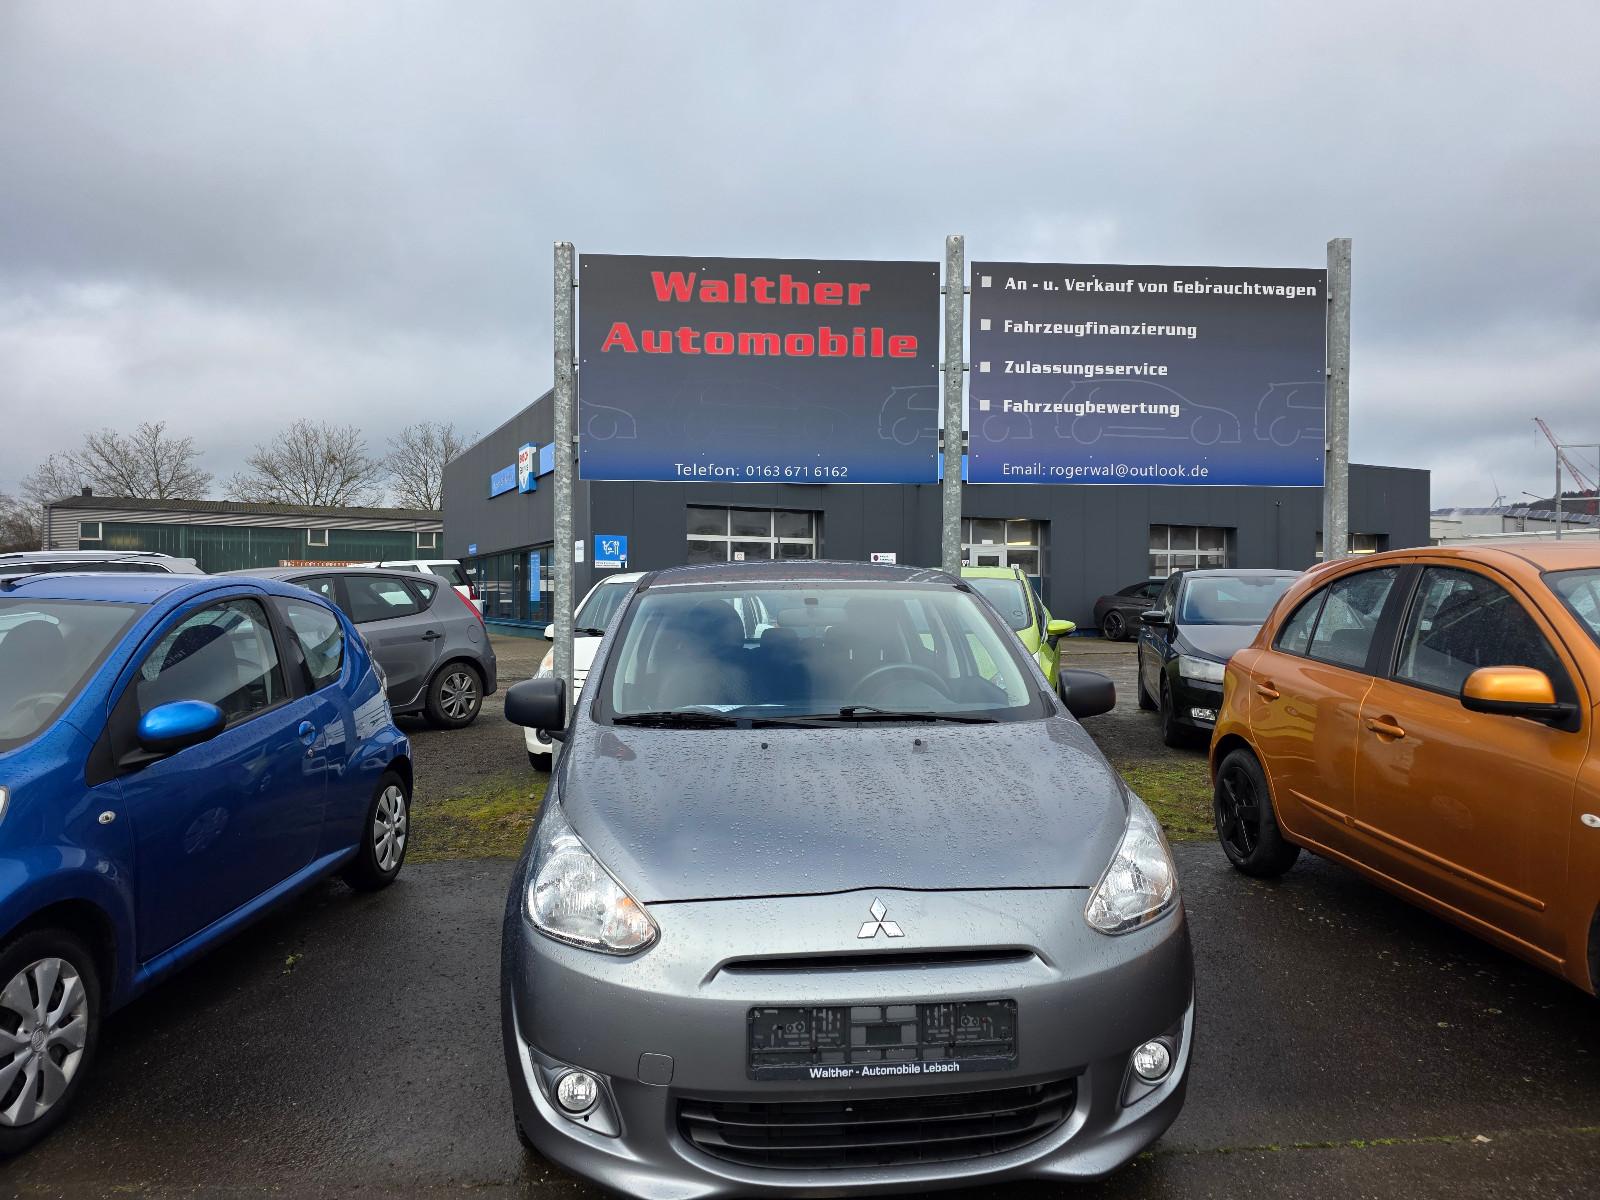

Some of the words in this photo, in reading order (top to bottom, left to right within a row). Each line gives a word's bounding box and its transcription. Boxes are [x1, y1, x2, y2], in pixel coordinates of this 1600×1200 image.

[651, 271, 871, 305] Walther
[1005, 276, 1027, 291] An
[1043, 280, 1060, 291] u.
[1064, 278, 1135, 293] Verkauf
[1137, 282, 1168, 293] von
[1172, 279, 1317, 298] Gebrauchtwagen
[1004, 319, 1197, 339] Fahrzeugfinanzierung
[601, 322, 918, 358] Automobile
[1004, 360, 1168, 378] Zulassungsservice
[1003, 399, 1180, 418] Fahrzeugbewertung
[675, 463, 740, 477] Telefon:
[746, 465, 780, 478] 0163
[784, 465, 808, 478] 671
[814, 465, 848, 478] 6162
[1003, 463, 1046, 476] Email:
[1050, 463, 1209, 480] rogerwal@outlook.de
[809, 1067, 854, 1079] Walther
[861, 1063, 921, 1077] Automobile
[923, 1061, 960, 1073] Lebach
